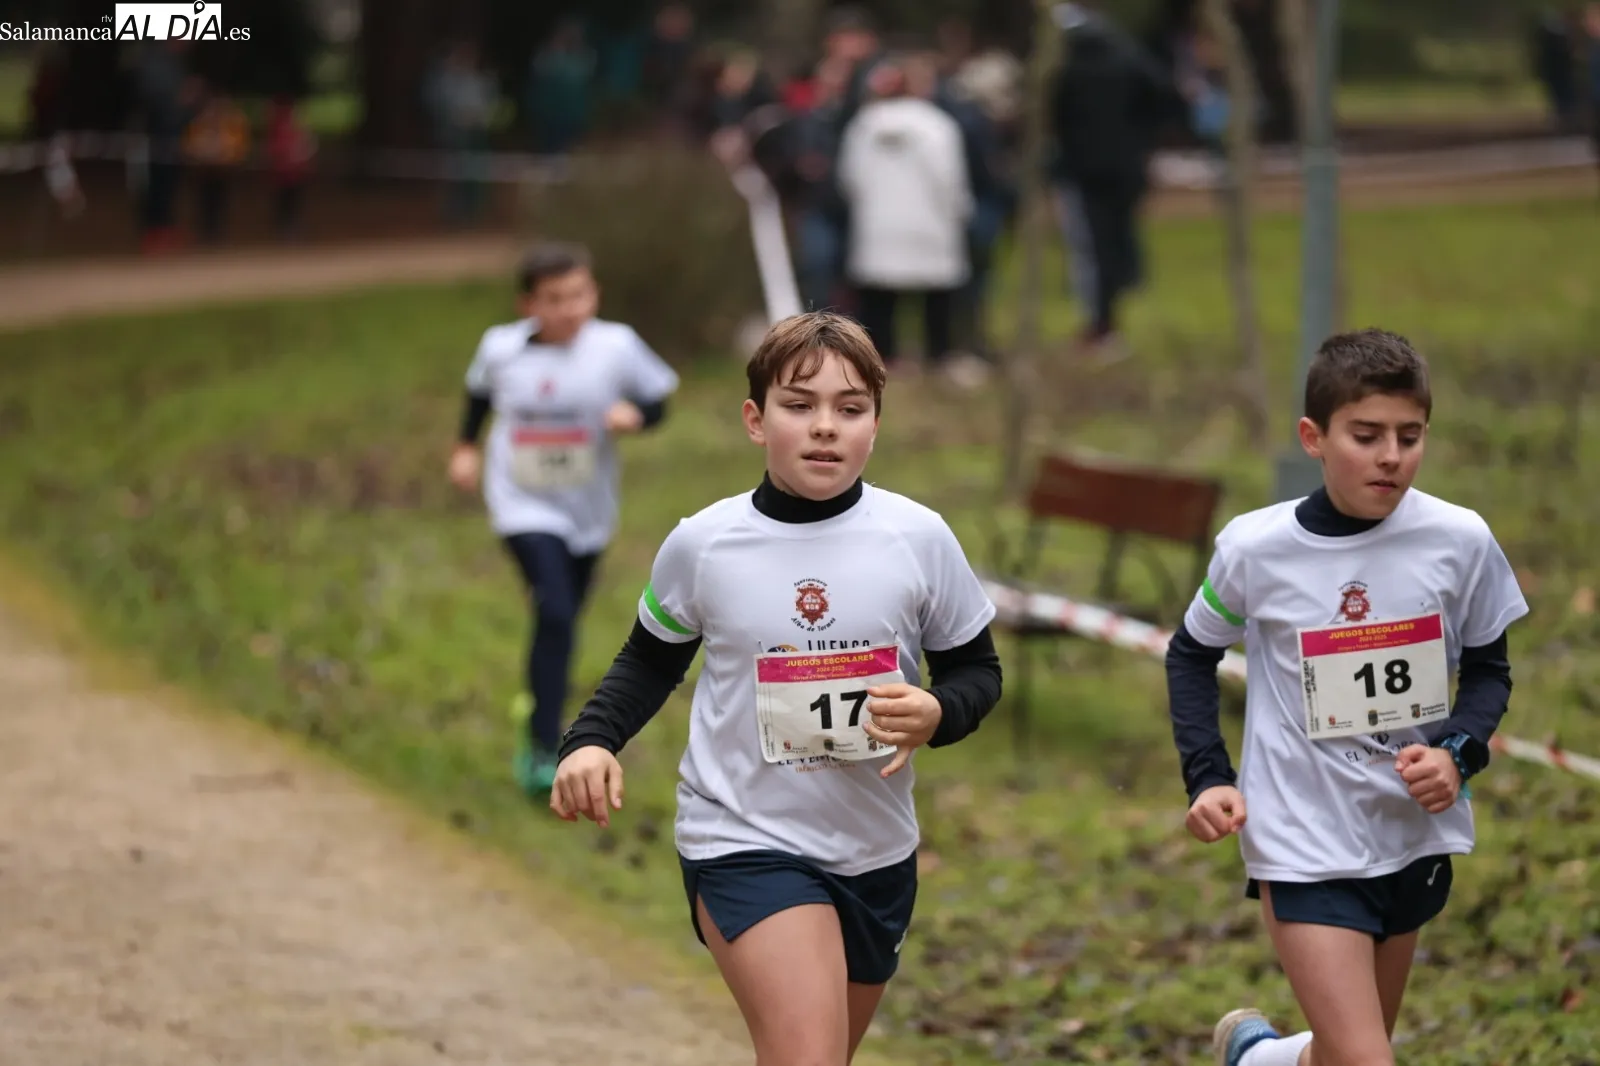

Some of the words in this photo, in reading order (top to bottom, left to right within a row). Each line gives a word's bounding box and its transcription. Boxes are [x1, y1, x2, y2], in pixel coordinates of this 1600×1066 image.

[1328, 629, 1364, 640] JUEGOS
[1365, 623, 1415, 635] ESCOLARES
[785, 658, 821, 667] JUEGOS
[823, 653, 875, 665] ESCOLARES
[1353, 658, 1412, 698] 18
[809, 689, 869, 730] 17
